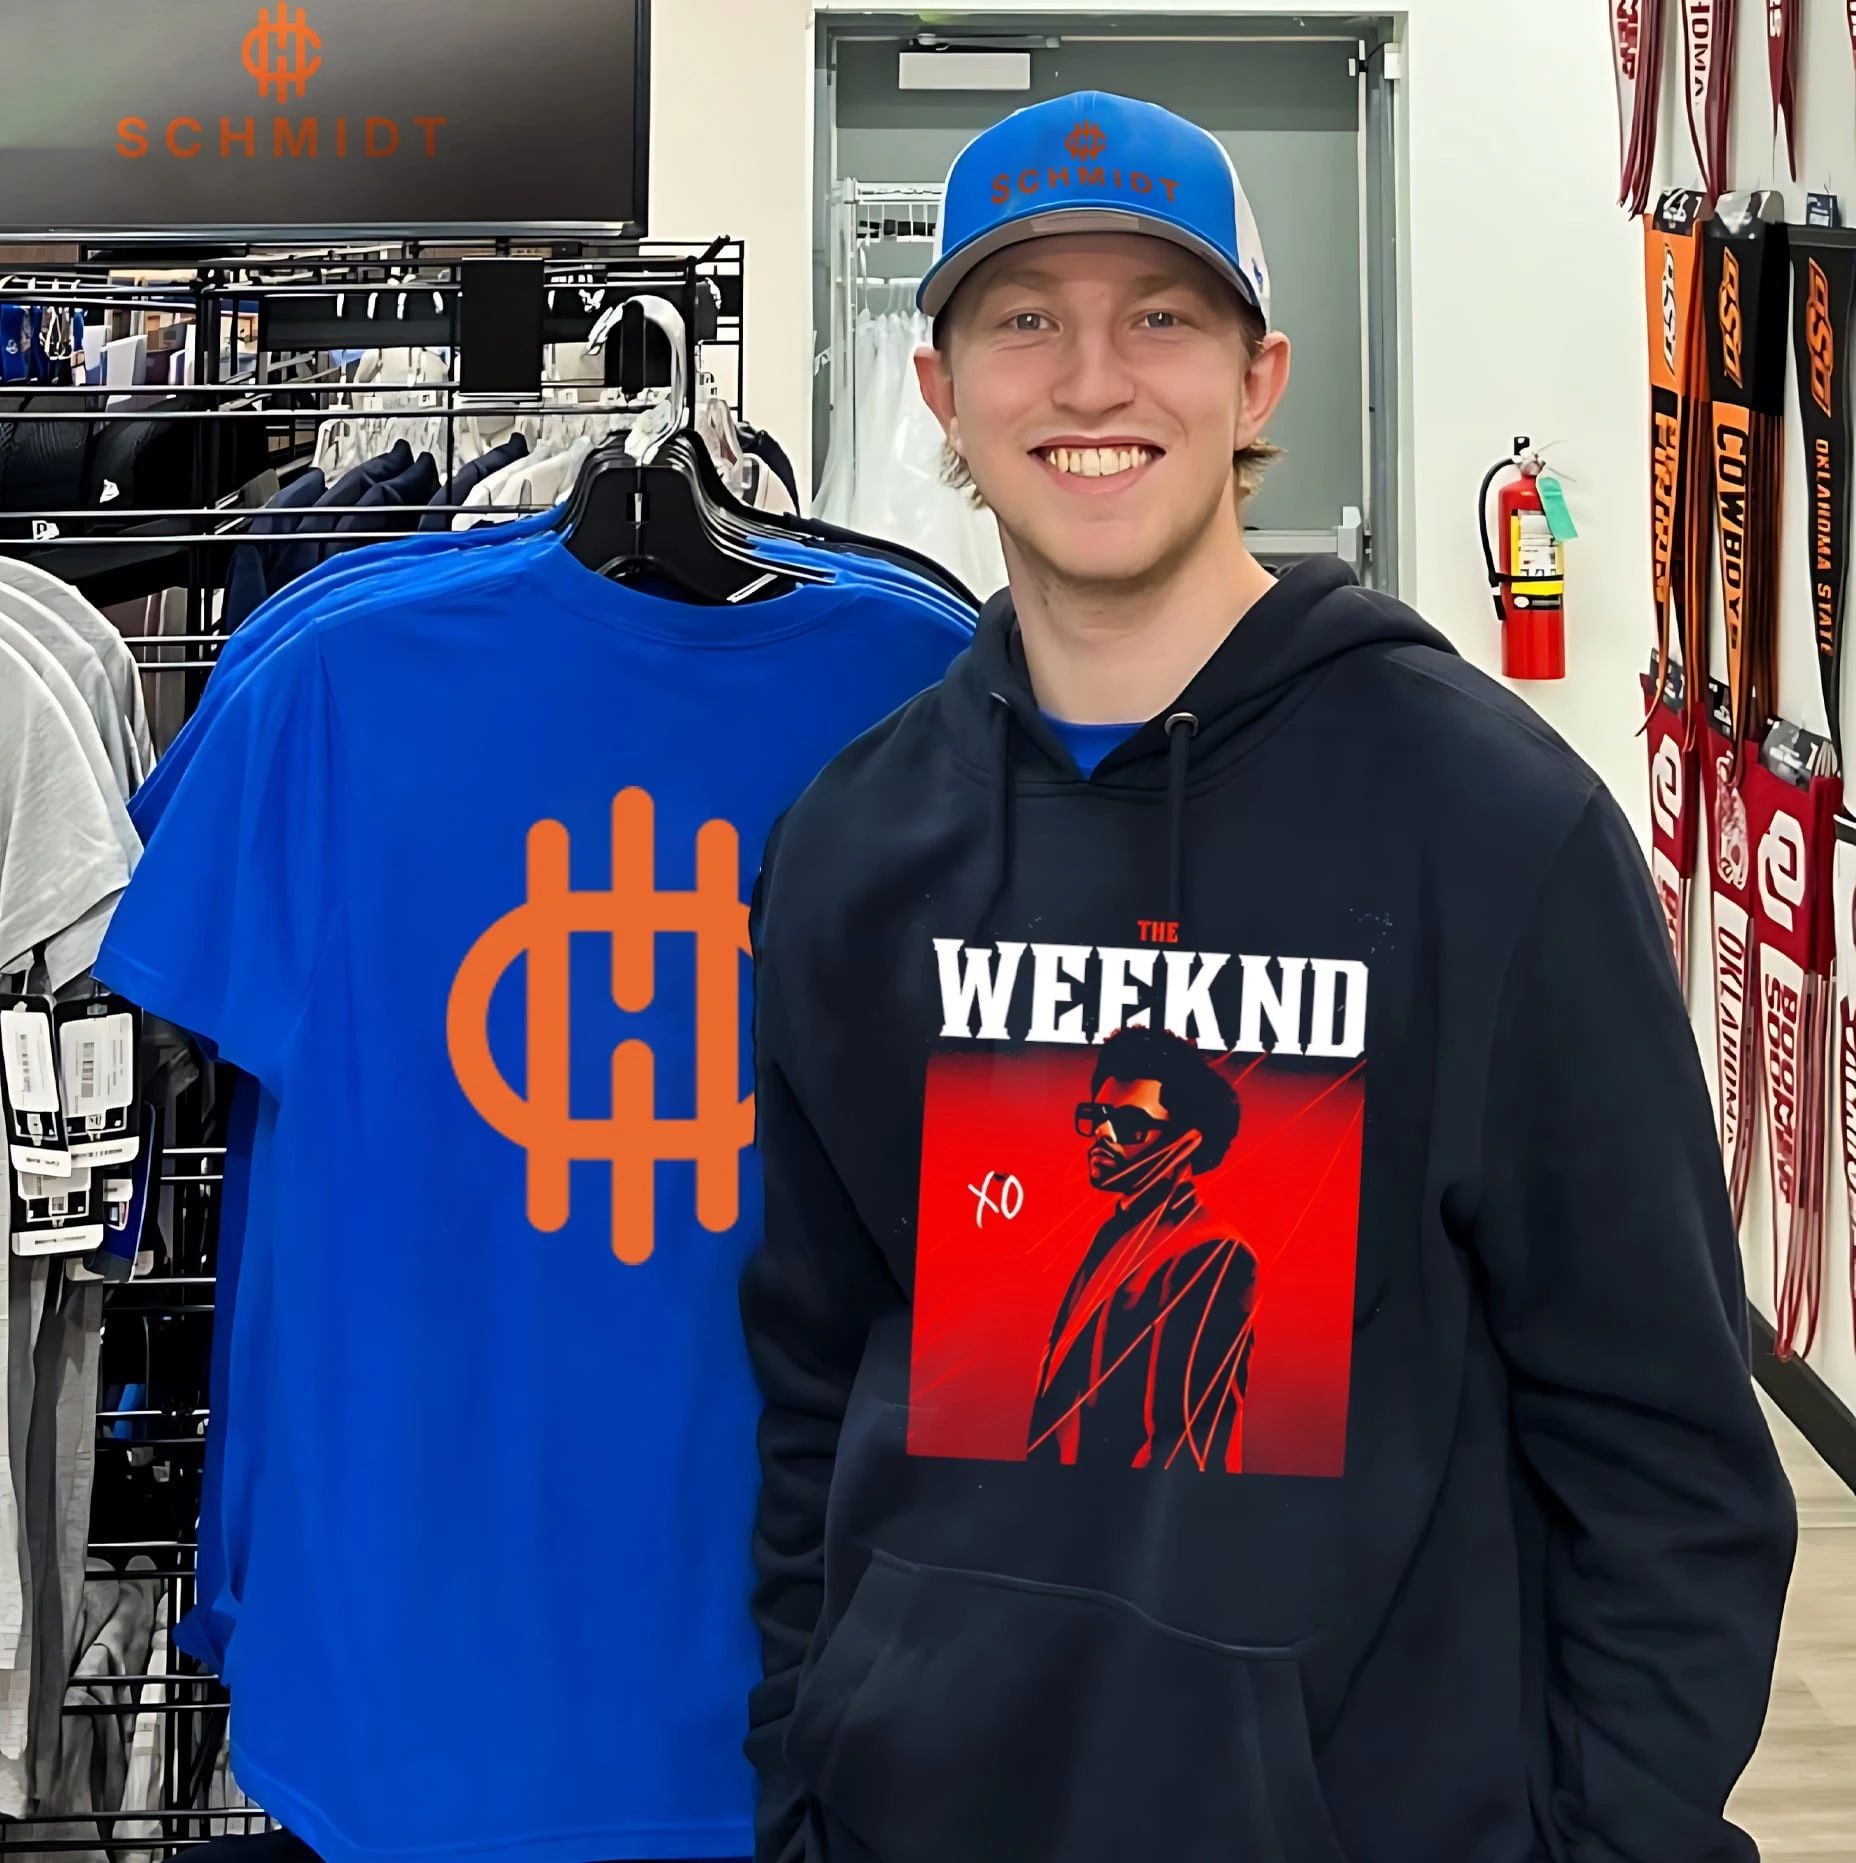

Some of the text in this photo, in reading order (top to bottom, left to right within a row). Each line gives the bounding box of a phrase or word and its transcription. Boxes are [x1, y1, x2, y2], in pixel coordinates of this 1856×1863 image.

[116, 117, 447, 158] SCHMIDT
[991, 166, 1180, 204] SCHMIDT
[1815, 438, 1832, 570] OKLAHOMA
[1137, 919, 1178, 943] THE
[932, 938, 1369, 1058] WEEKND
[1718, 926, 1745, 1144] OKLAHOMA
[967, 1170, 1024, 1228] XO
